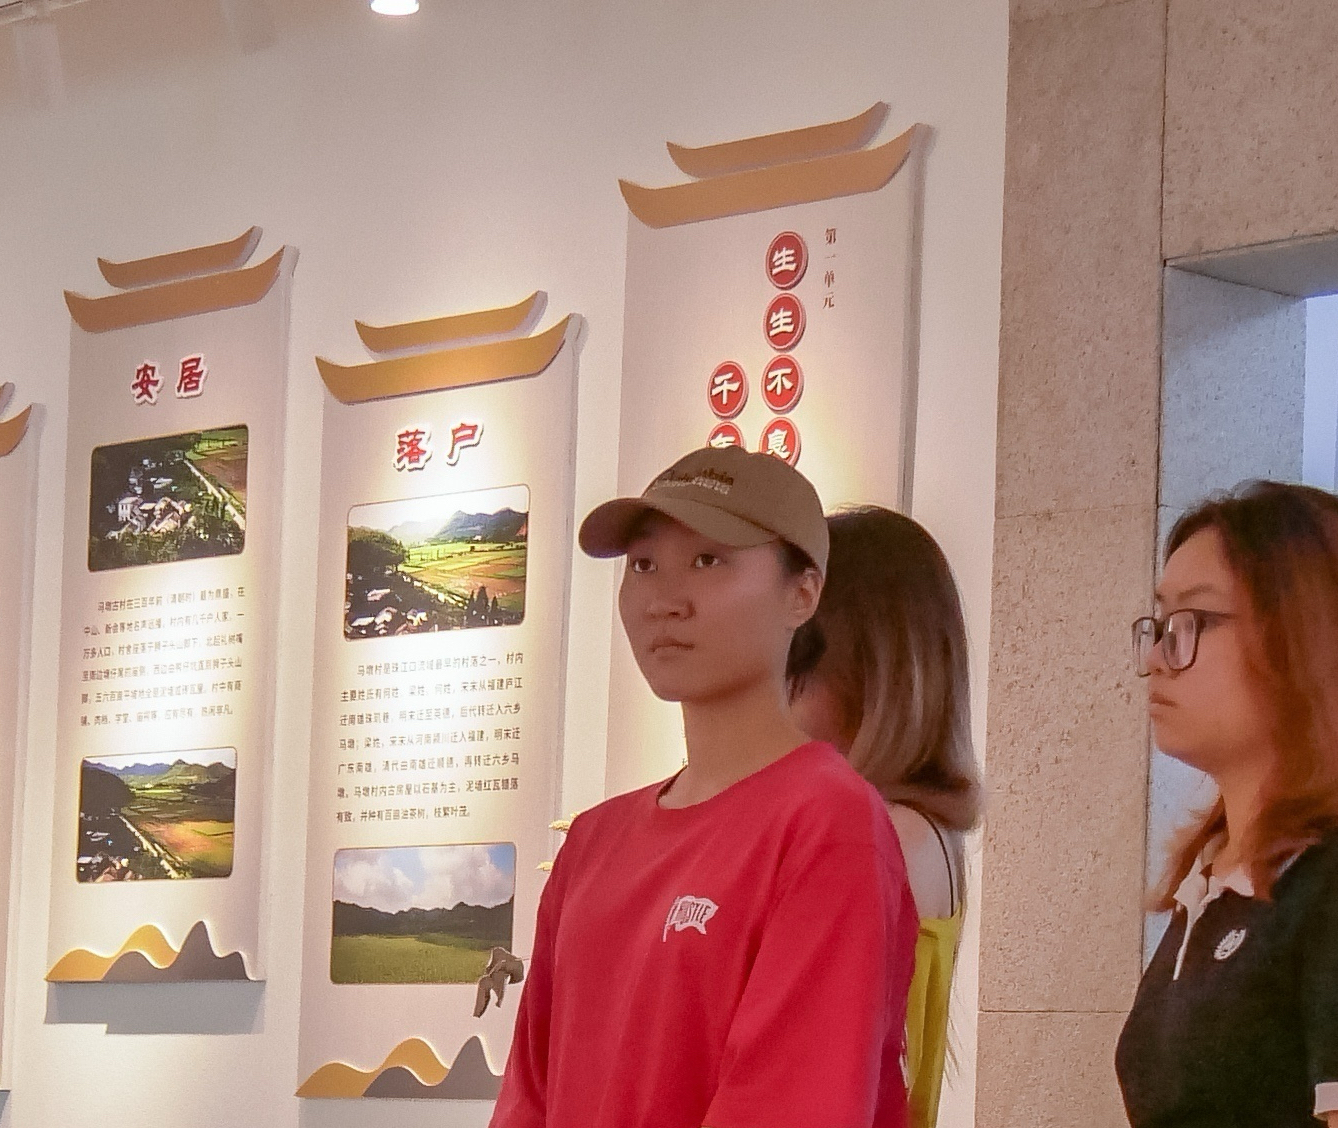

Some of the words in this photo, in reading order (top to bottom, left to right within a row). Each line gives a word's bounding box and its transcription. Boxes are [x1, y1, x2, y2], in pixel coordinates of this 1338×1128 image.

[766, 246, 797, 460] 生生不息
[132, 357, 204, 399] 安居
[397, 423, 478, 463] 落户
